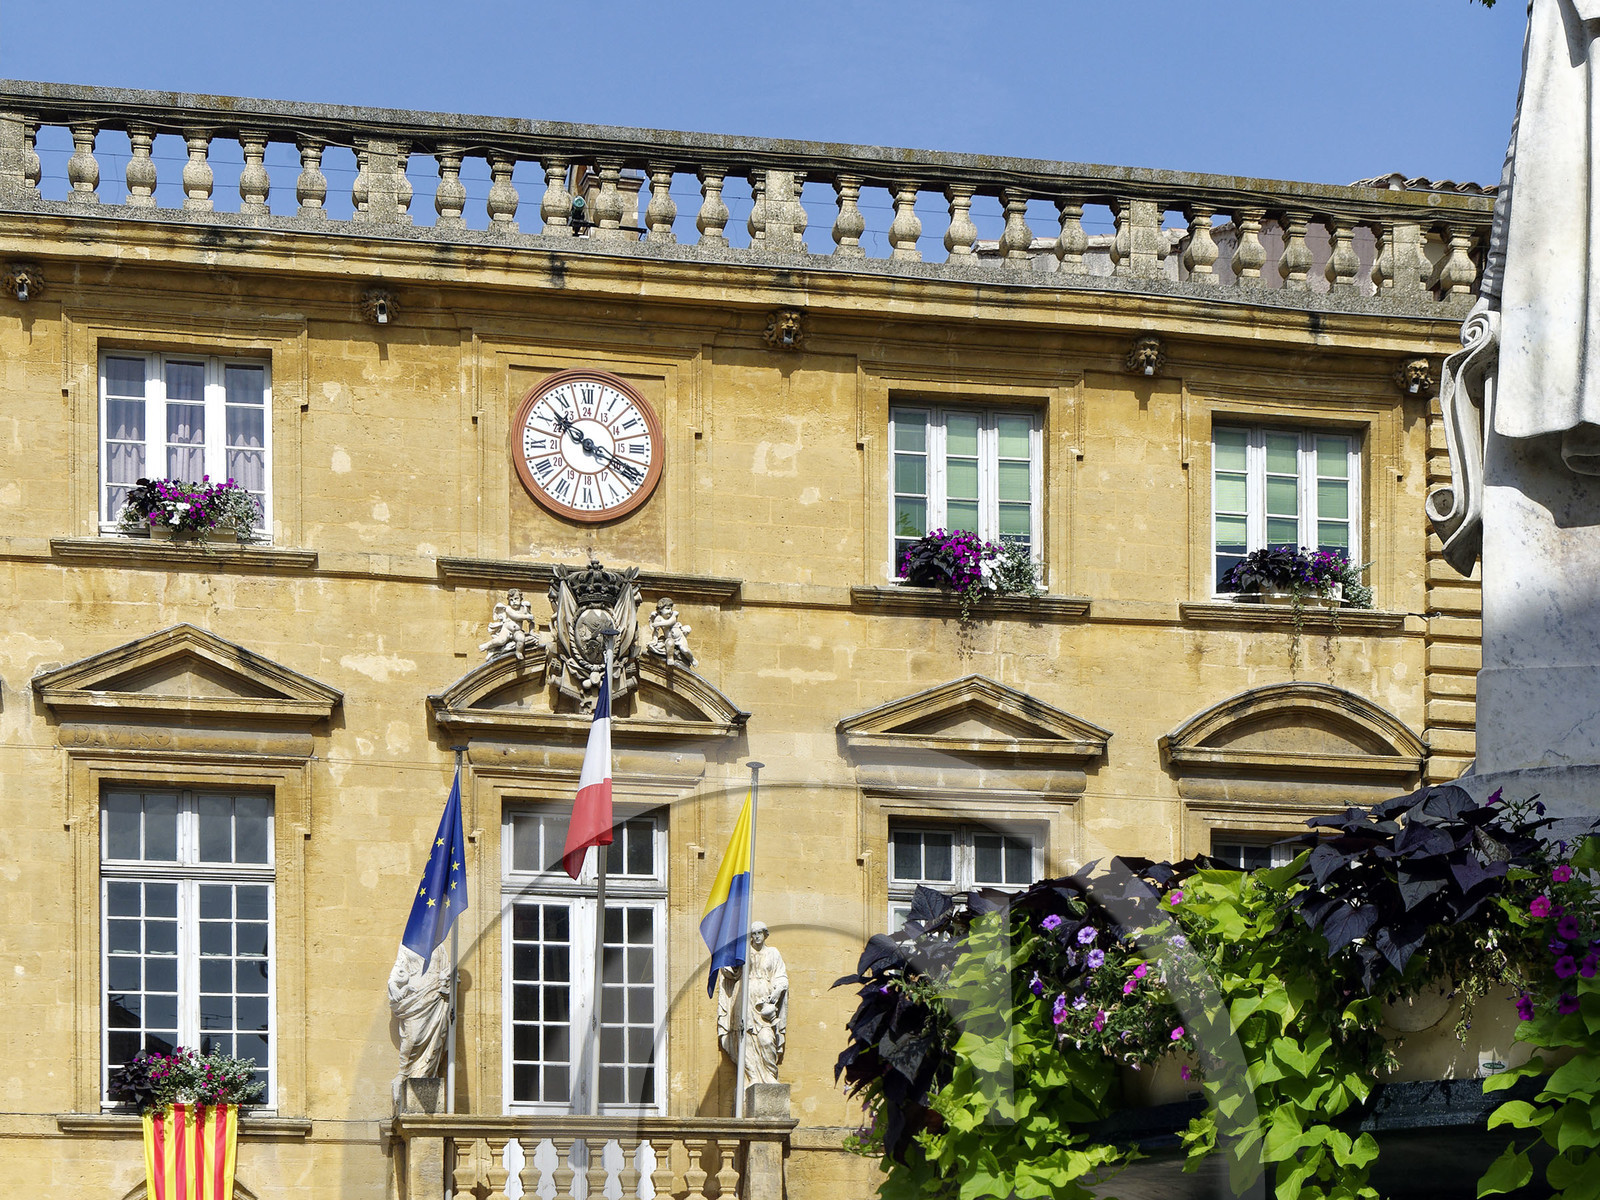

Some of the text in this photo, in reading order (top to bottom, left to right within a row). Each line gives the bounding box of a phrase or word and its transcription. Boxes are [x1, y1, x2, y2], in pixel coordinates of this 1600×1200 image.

[581, 388, 594, 405] XII
[582, 407, 592, 417] 24
[600, 413, 608, 423] 13
[613, 426, 620, 436] 14
[550, 440, 558, 450] 21
[617, 443, 625, 453] 15
[629, 444, 645, 455] III
[553, 457, 563, 467] 20
[567, 470, 575, 480] 19
[584, 475, 592, 485] 18
[601, 472, 608, 482] 17
